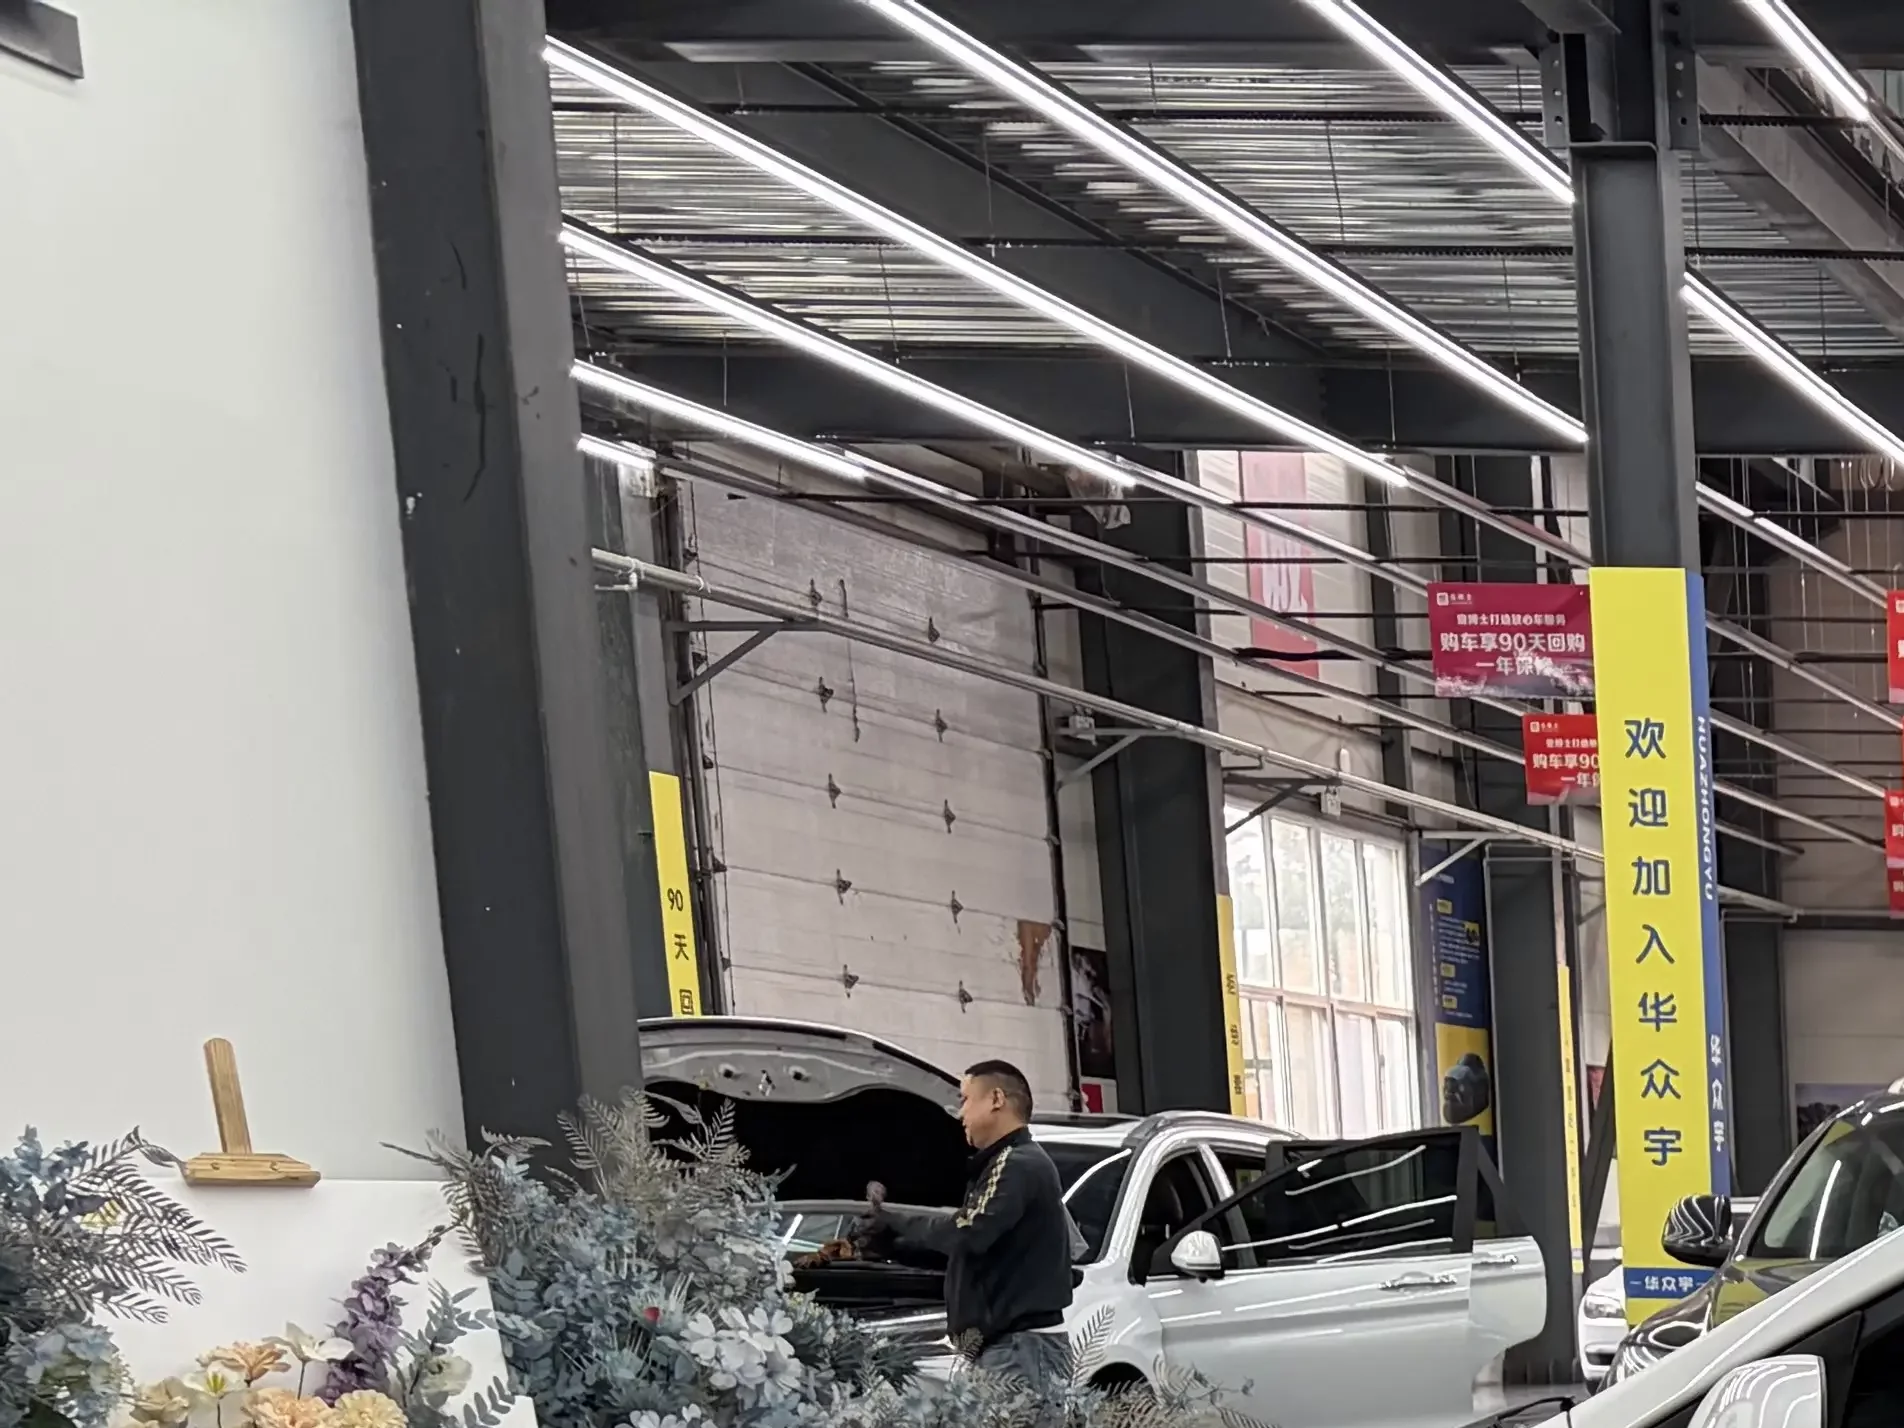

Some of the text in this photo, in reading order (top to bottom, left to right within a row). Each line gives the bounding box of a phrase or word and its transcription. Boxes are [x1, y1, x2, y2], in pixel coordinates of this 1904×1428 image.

[1440, 632, 1586, 652] 购车享90天回购
[1695, 715, 1714, 901] HUAZHONGYU
[1624, 717, 1683, 1168] 欢迎加入华众宇
[1708, 1032, 1726, 1152] 华众宇
[1644, 1275, 1694, 1292] 华众宇
